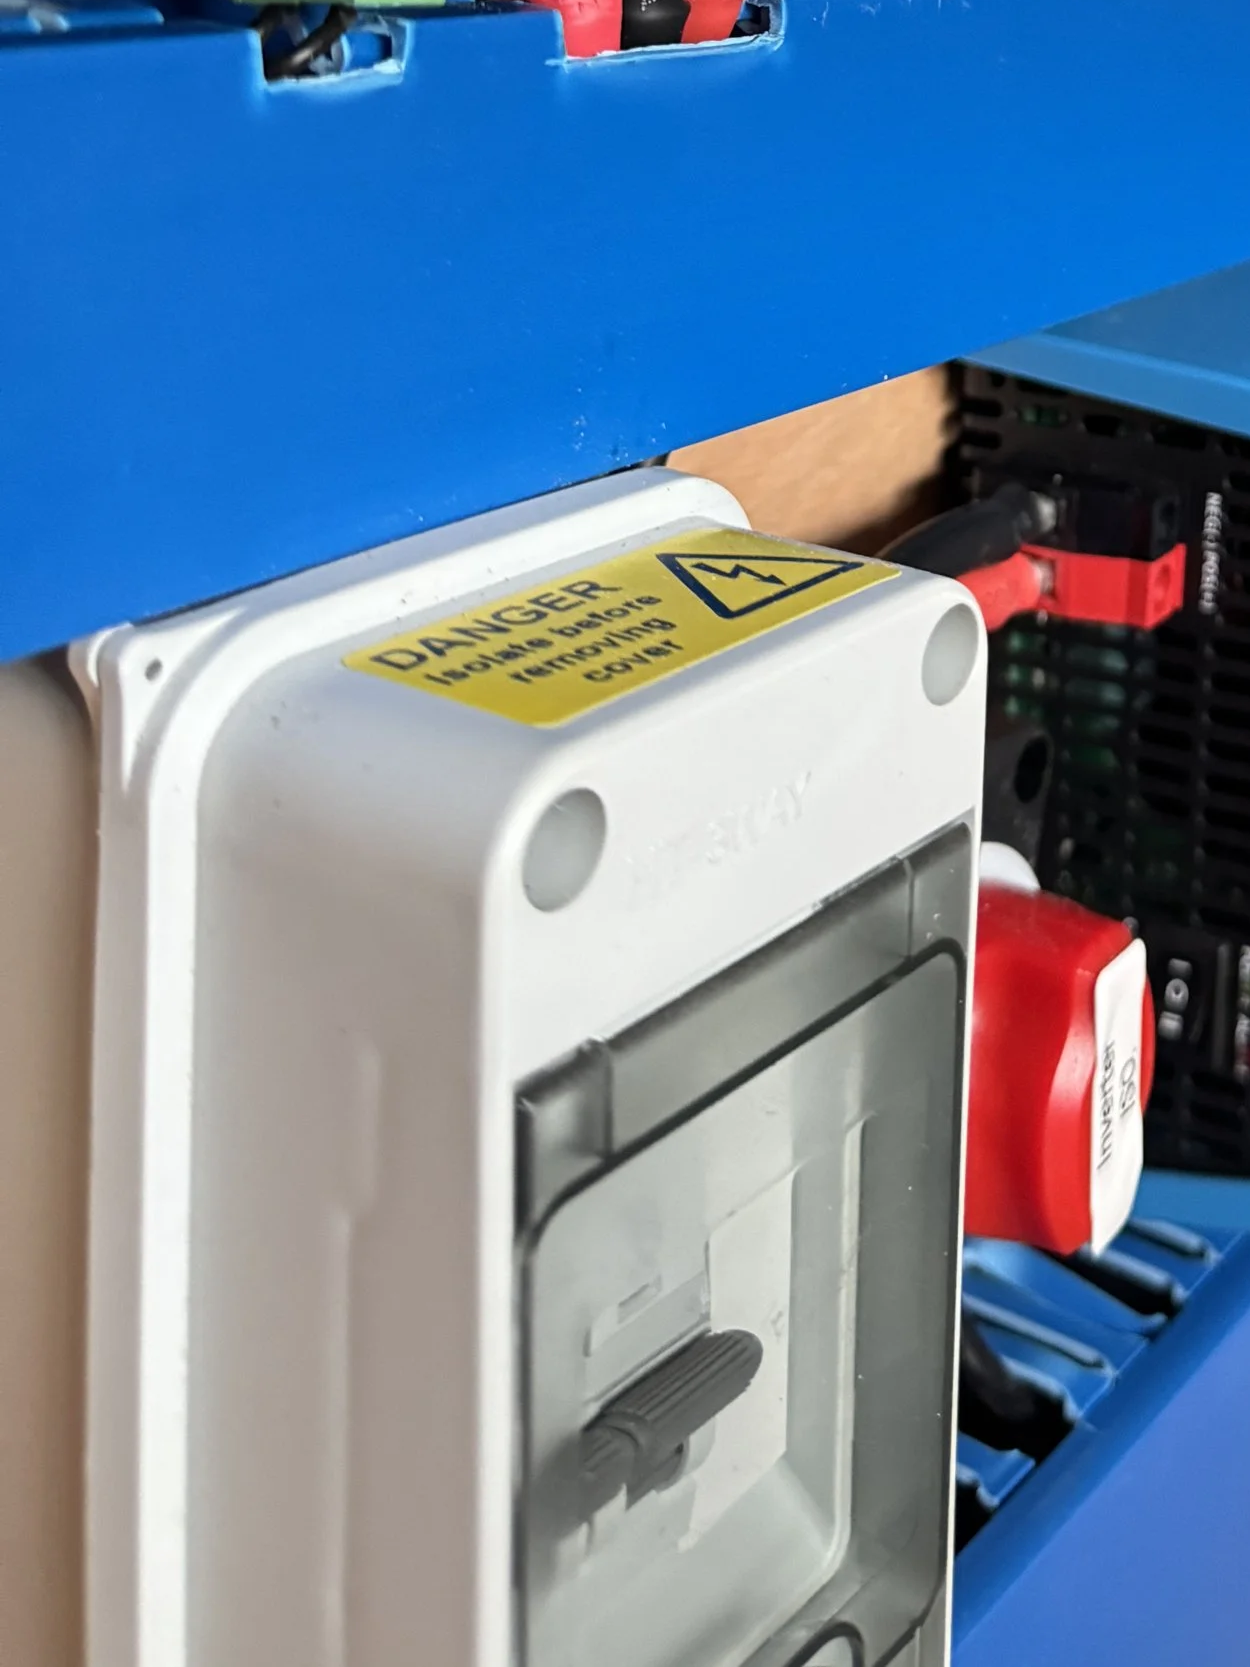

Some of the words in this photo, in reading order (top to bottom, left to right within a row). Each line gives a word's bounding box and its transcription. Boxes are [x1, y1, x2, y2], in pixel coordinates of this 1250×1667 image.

[370, 579, 623, 671] DANGER
[424, 637, 554, 686] Isolate
[549, 595, 663, 638] before
[508, 616, 678, 684] removing
[583, 638, 685, 683] cover
[1097, 1040, 1115, 1169] Inverter
